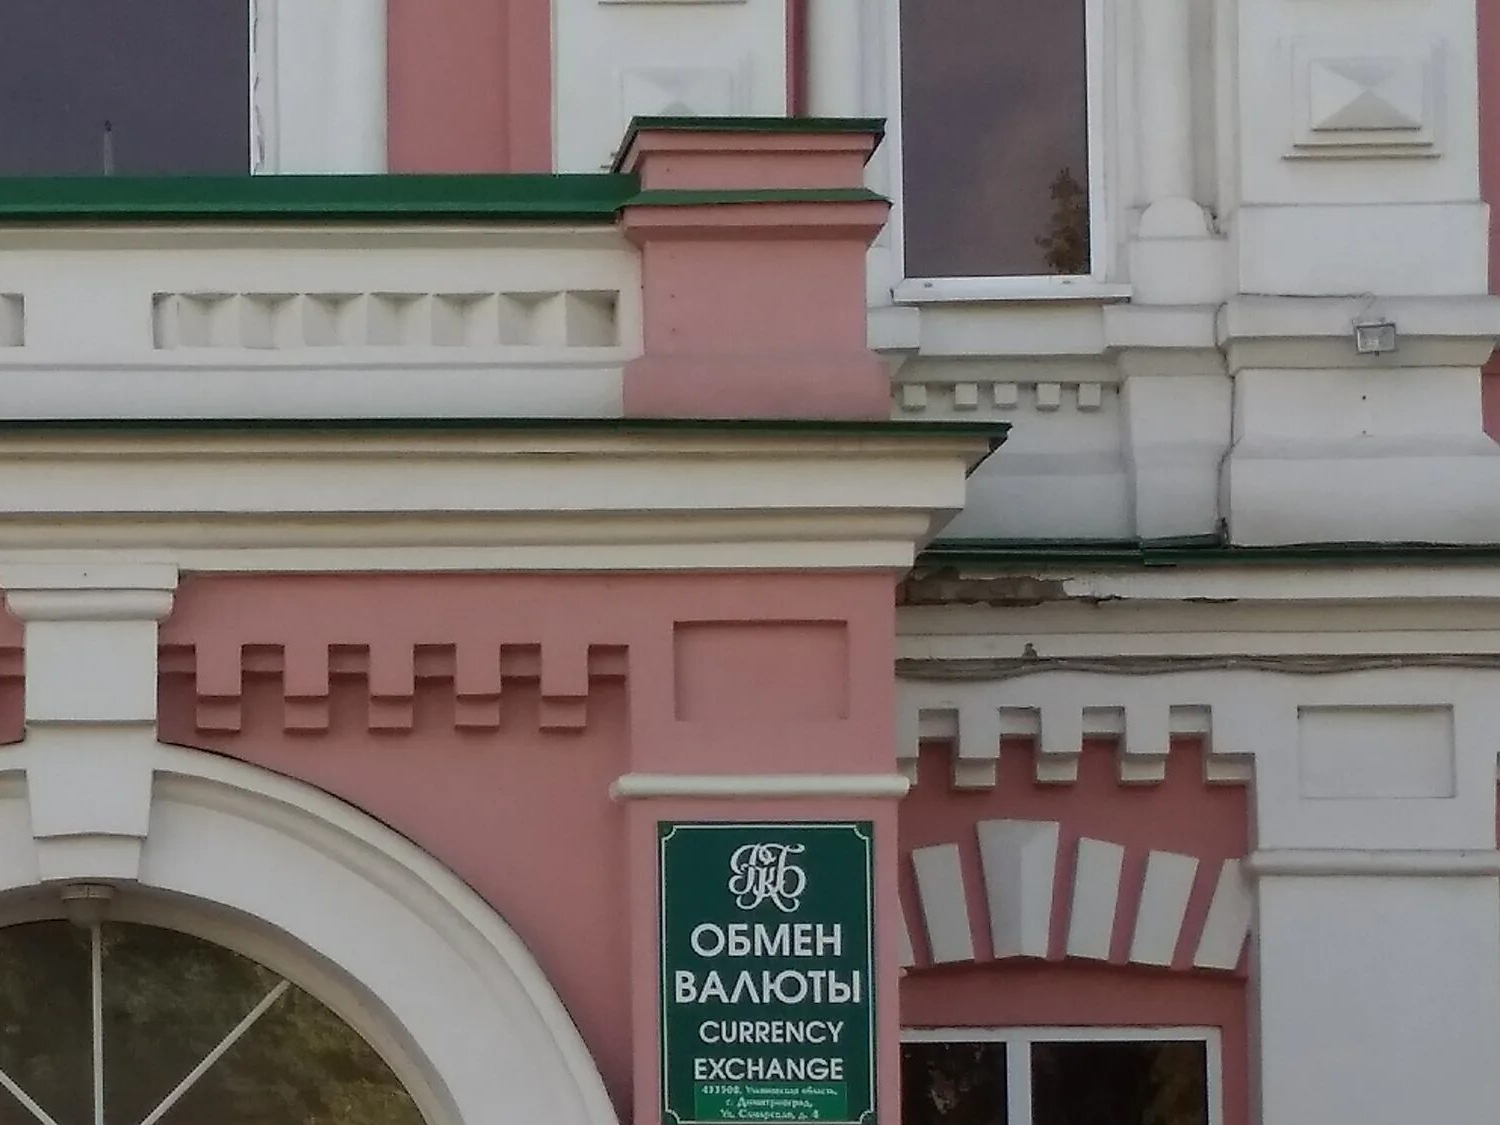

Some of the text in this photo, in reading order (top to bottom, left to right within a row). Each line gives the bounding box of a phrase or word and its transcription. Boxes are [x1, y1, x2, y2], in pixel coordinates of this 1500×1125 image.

[690, 922, 842, 957] ОБМЕН
[675, 969, 861, 1004] ВАЛЮТЫ
[699, 1020, 844, 1043] CURRENCY
[693, 1057, 844, 1081] EXCHANGE
